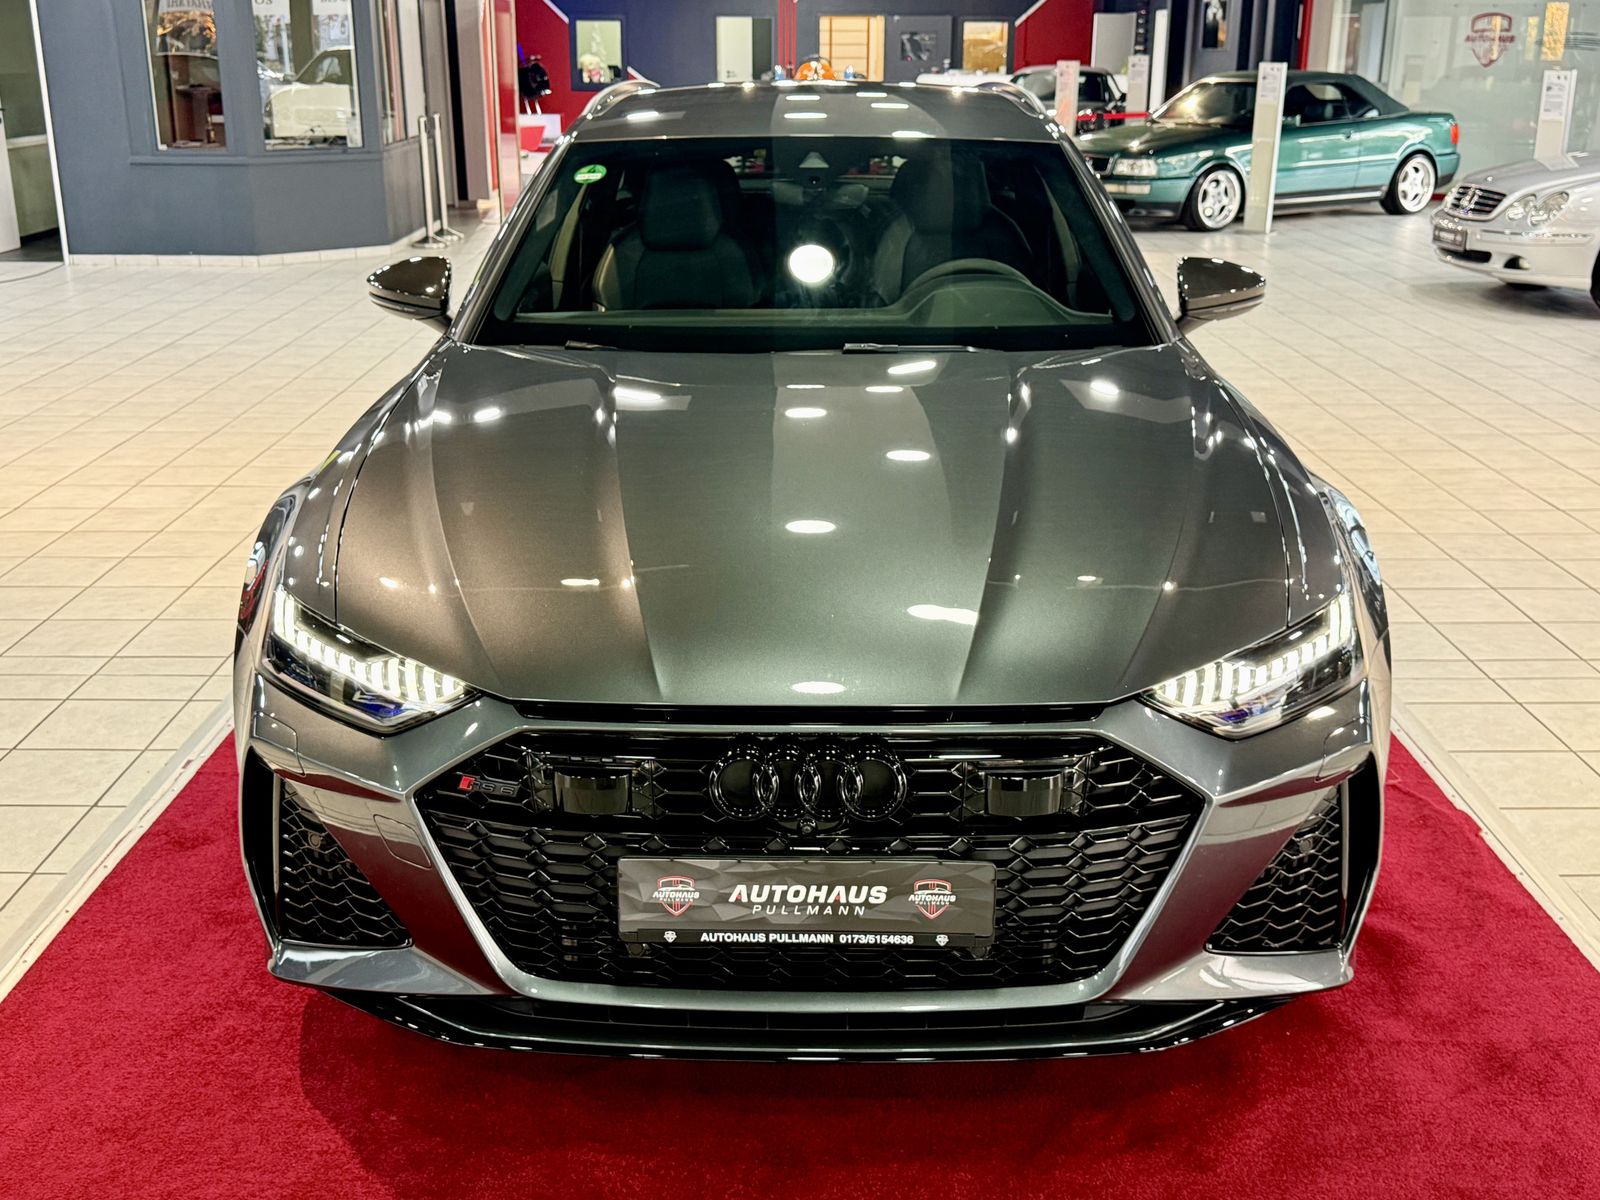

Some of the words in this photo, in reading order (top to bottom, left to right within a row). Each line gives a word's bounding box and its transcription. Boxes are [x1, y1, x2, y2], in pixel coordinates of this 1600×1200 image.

[653, 891, 700, 899] AUTOHAUS
[728, 884, 888, 904] AUTOHAUS
[908, 894, 957, 902] AUTOHAUS
[752, 904, 865, 916] PULLMANN
[700, 932, 766, 942] AUTOHAUS
[768, 933, 834, 943] PULLMANN
[839, 934, 914, 944] 0173/5154636
